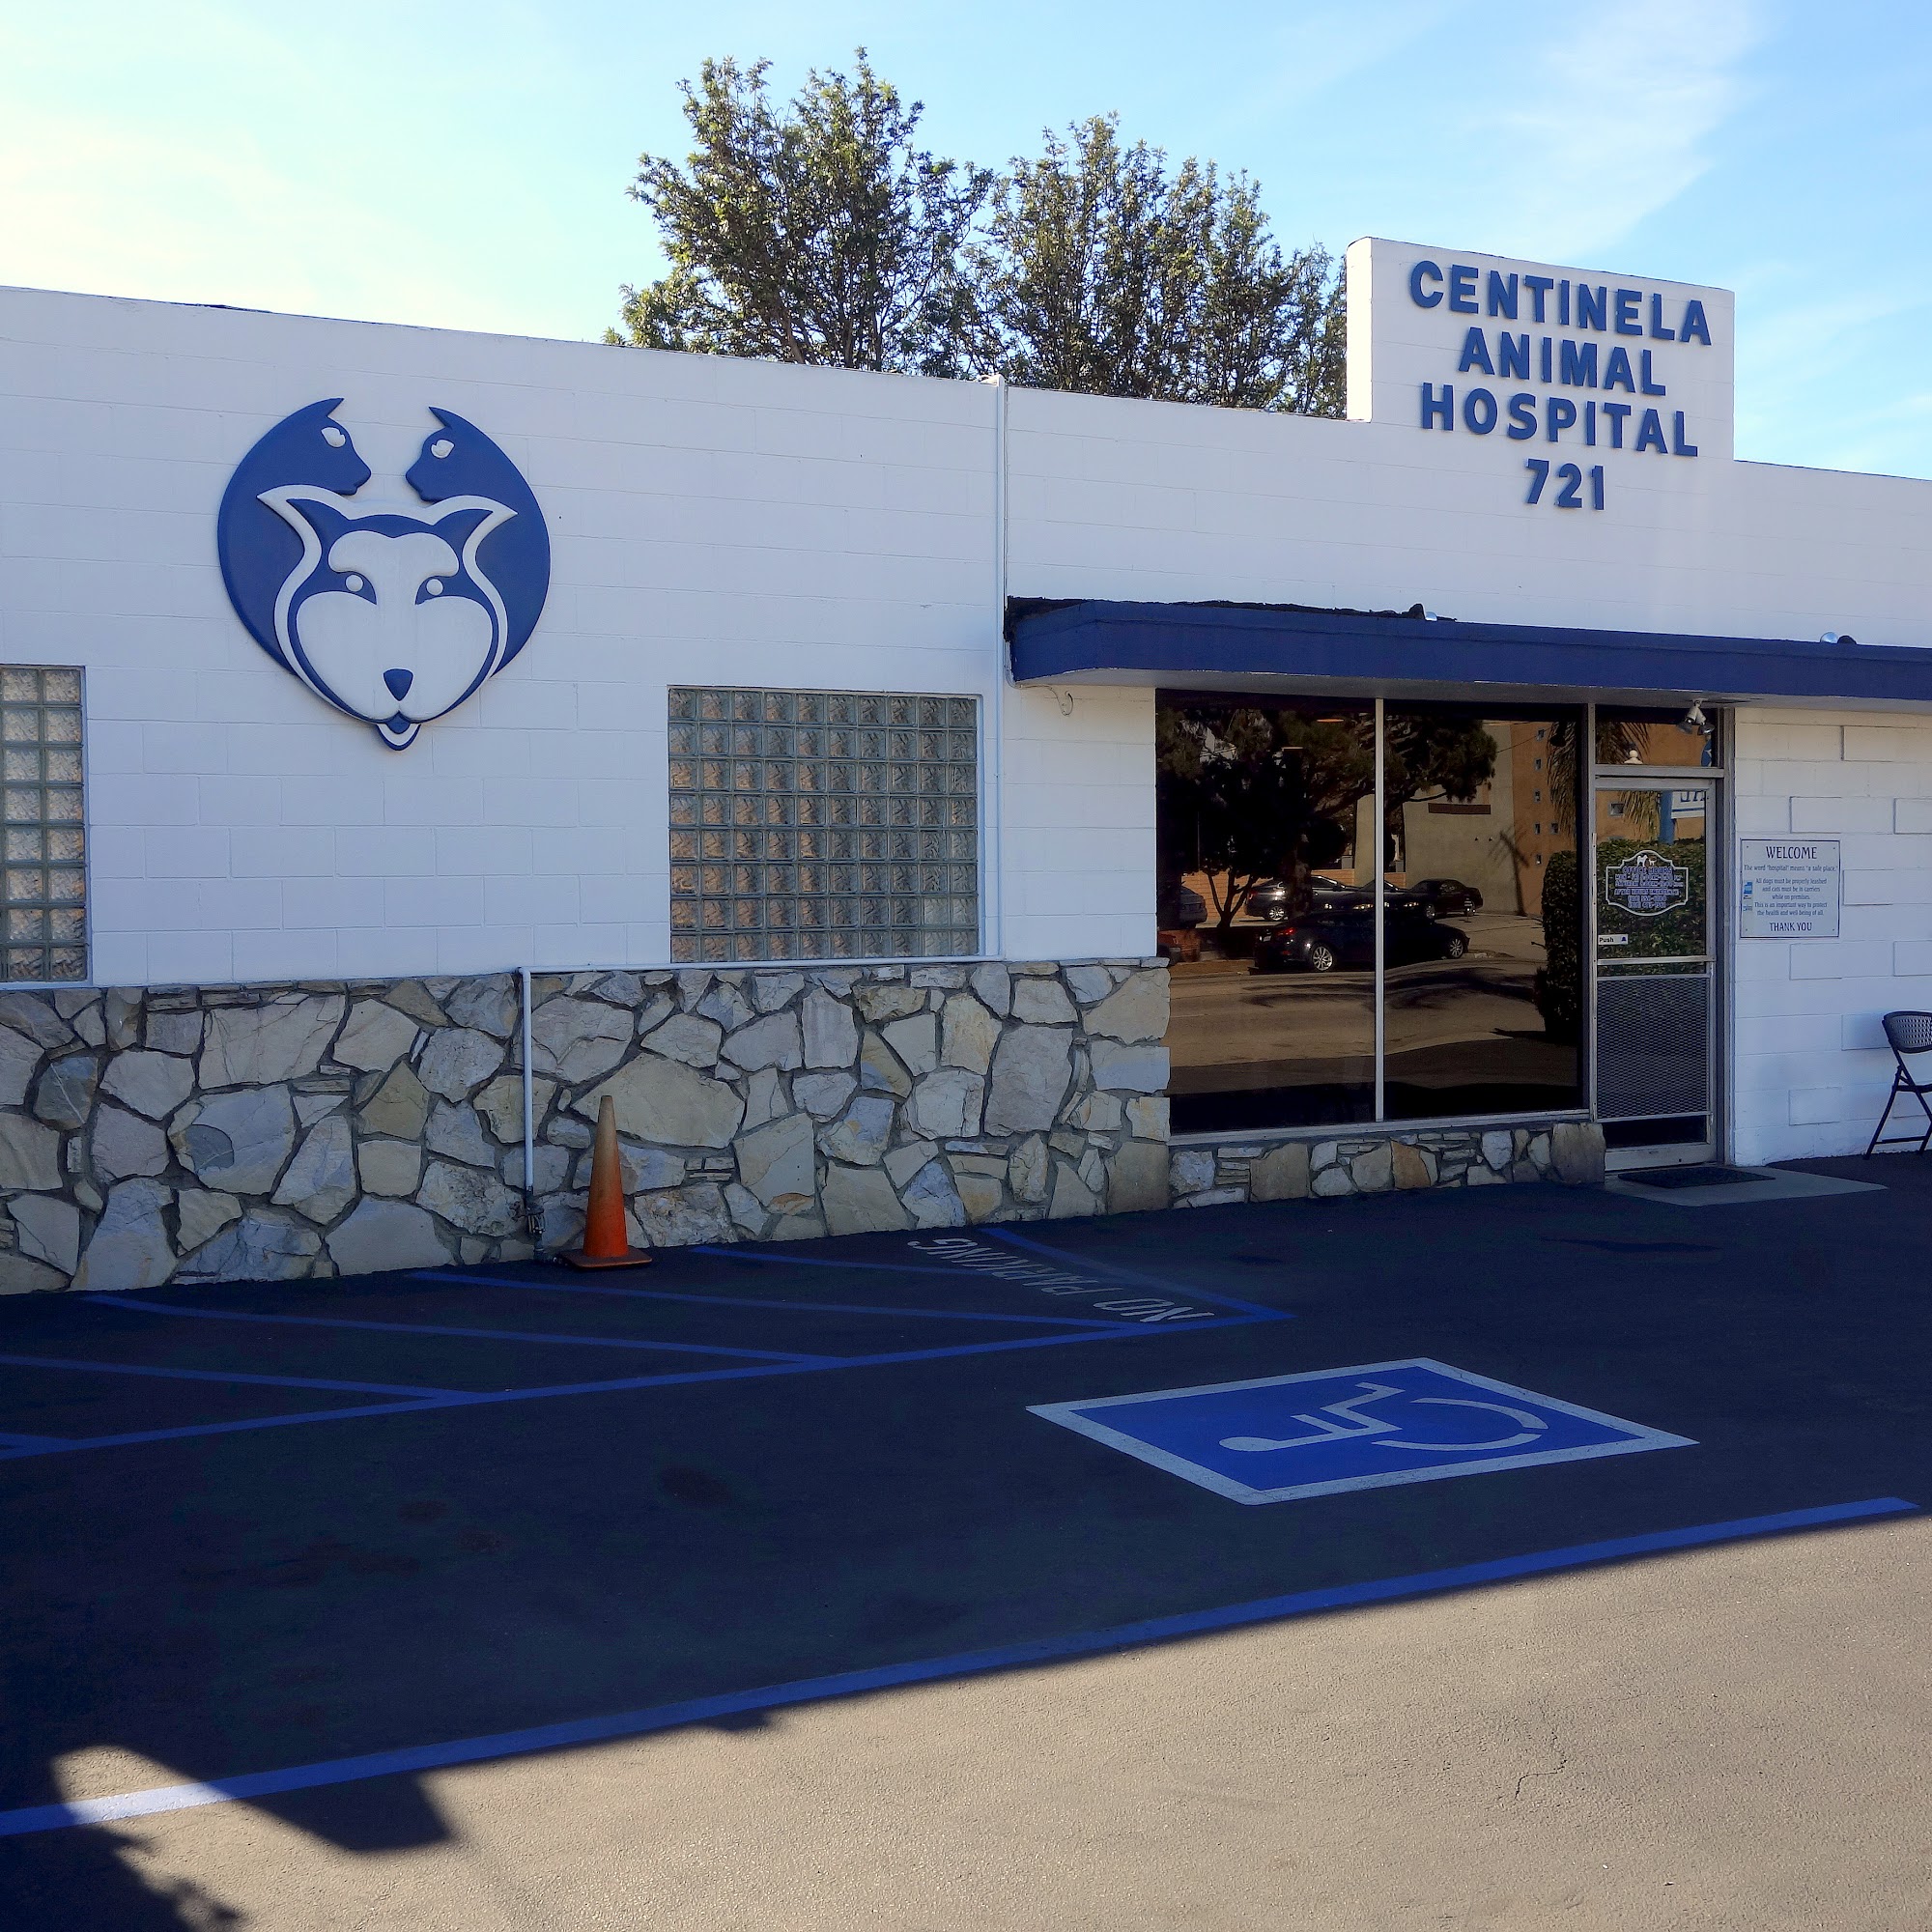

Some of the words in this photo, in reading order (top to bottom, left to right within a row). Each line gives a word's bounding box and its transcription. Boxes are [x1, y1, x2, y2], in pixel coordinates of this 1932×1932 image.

[1410, 260, 1712, 346] CENTINELA
[1458, 327, 1666, 396] ANIMAL
[1422, 382, 1698, 457] HOSPITAL
[1525, 458, 1605, 511] 721
[1766, 846, 1817, 859] WELCOME
[1770, 923, 1796, 931] THANK
[1797, 923, 1812, 931] YOU
[907, 1237, 1123, 1296] PARKING
[1093, 1297, 1215, 1322] NO
